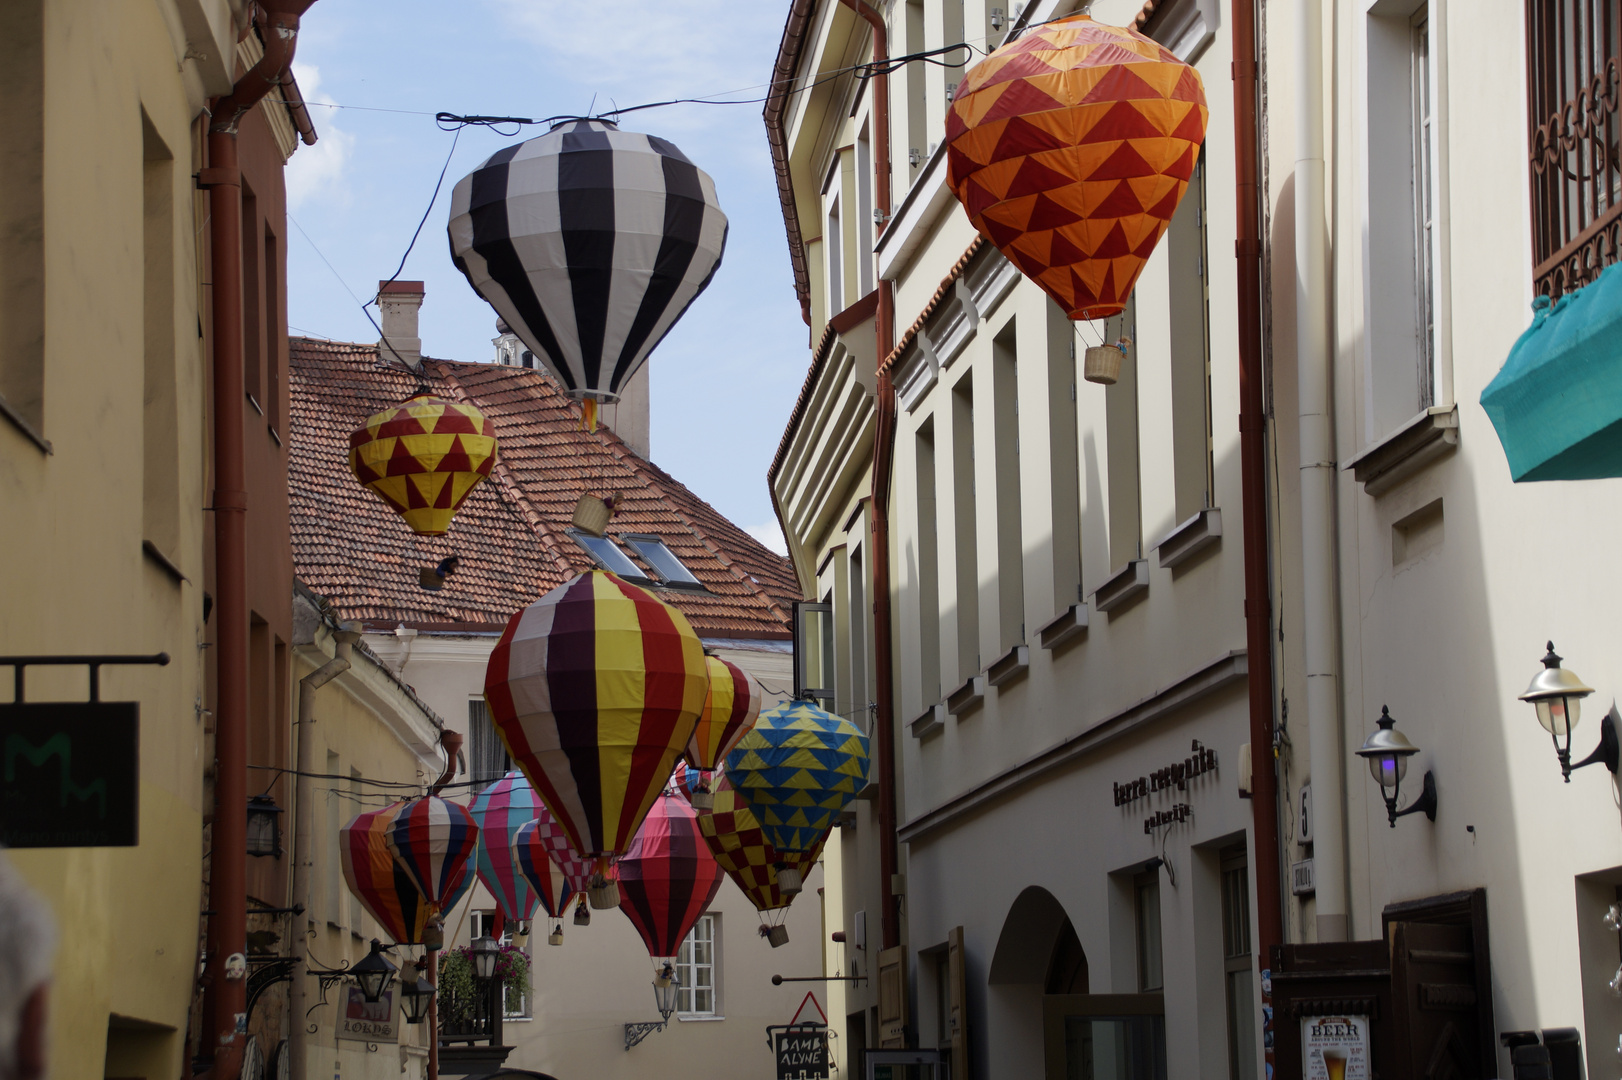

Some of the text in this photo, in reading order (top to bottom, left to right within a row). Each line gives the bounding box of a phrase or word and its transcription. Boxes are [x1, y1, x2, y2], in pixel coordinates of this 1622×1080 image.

[1113, 739, 1215, 807] terra recognita
[1144, 803, 1190, 834] galerija
[1301, 791, 1308, 837] 5
[344, 1020, 392, 1036] LOKYS
[1311, 1024, 1359, 1037] BEER
[780, 1037, 821, 1053] BAMB
